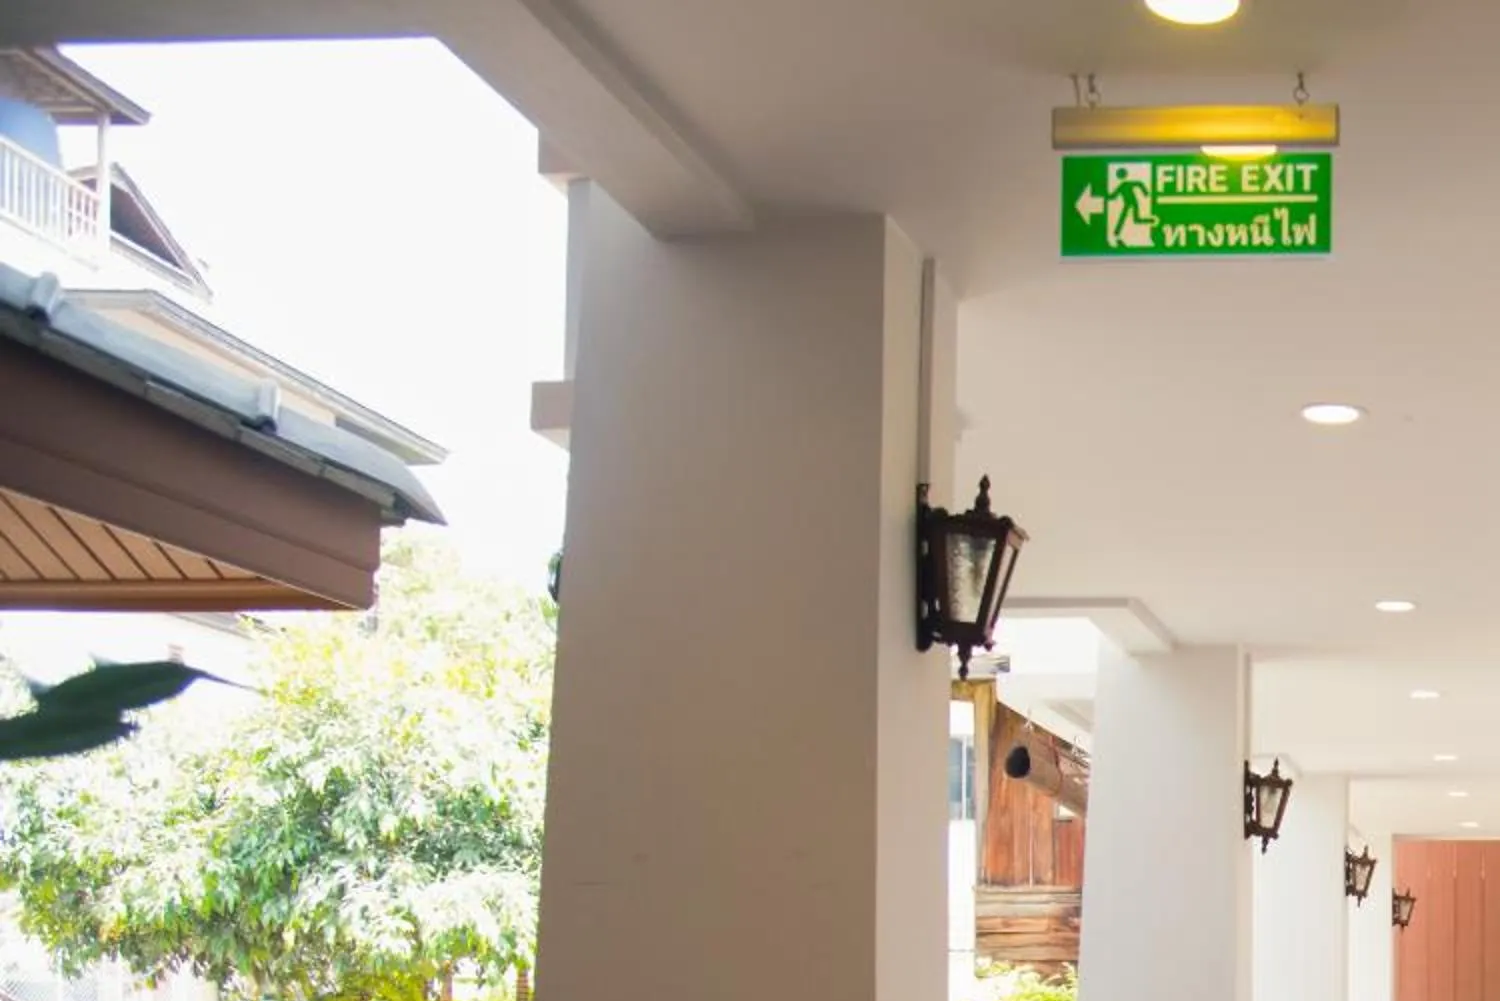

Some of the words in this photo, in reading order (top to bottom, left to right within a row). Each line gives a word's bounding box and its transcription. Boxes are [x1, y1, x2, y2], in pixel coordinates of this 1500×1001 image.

[1156, 164, 1228, 193] FIRE
[1241, 163, 1318, 192] EXIT
[1162, 207, 1317, 247] ทางหนีไฟ
